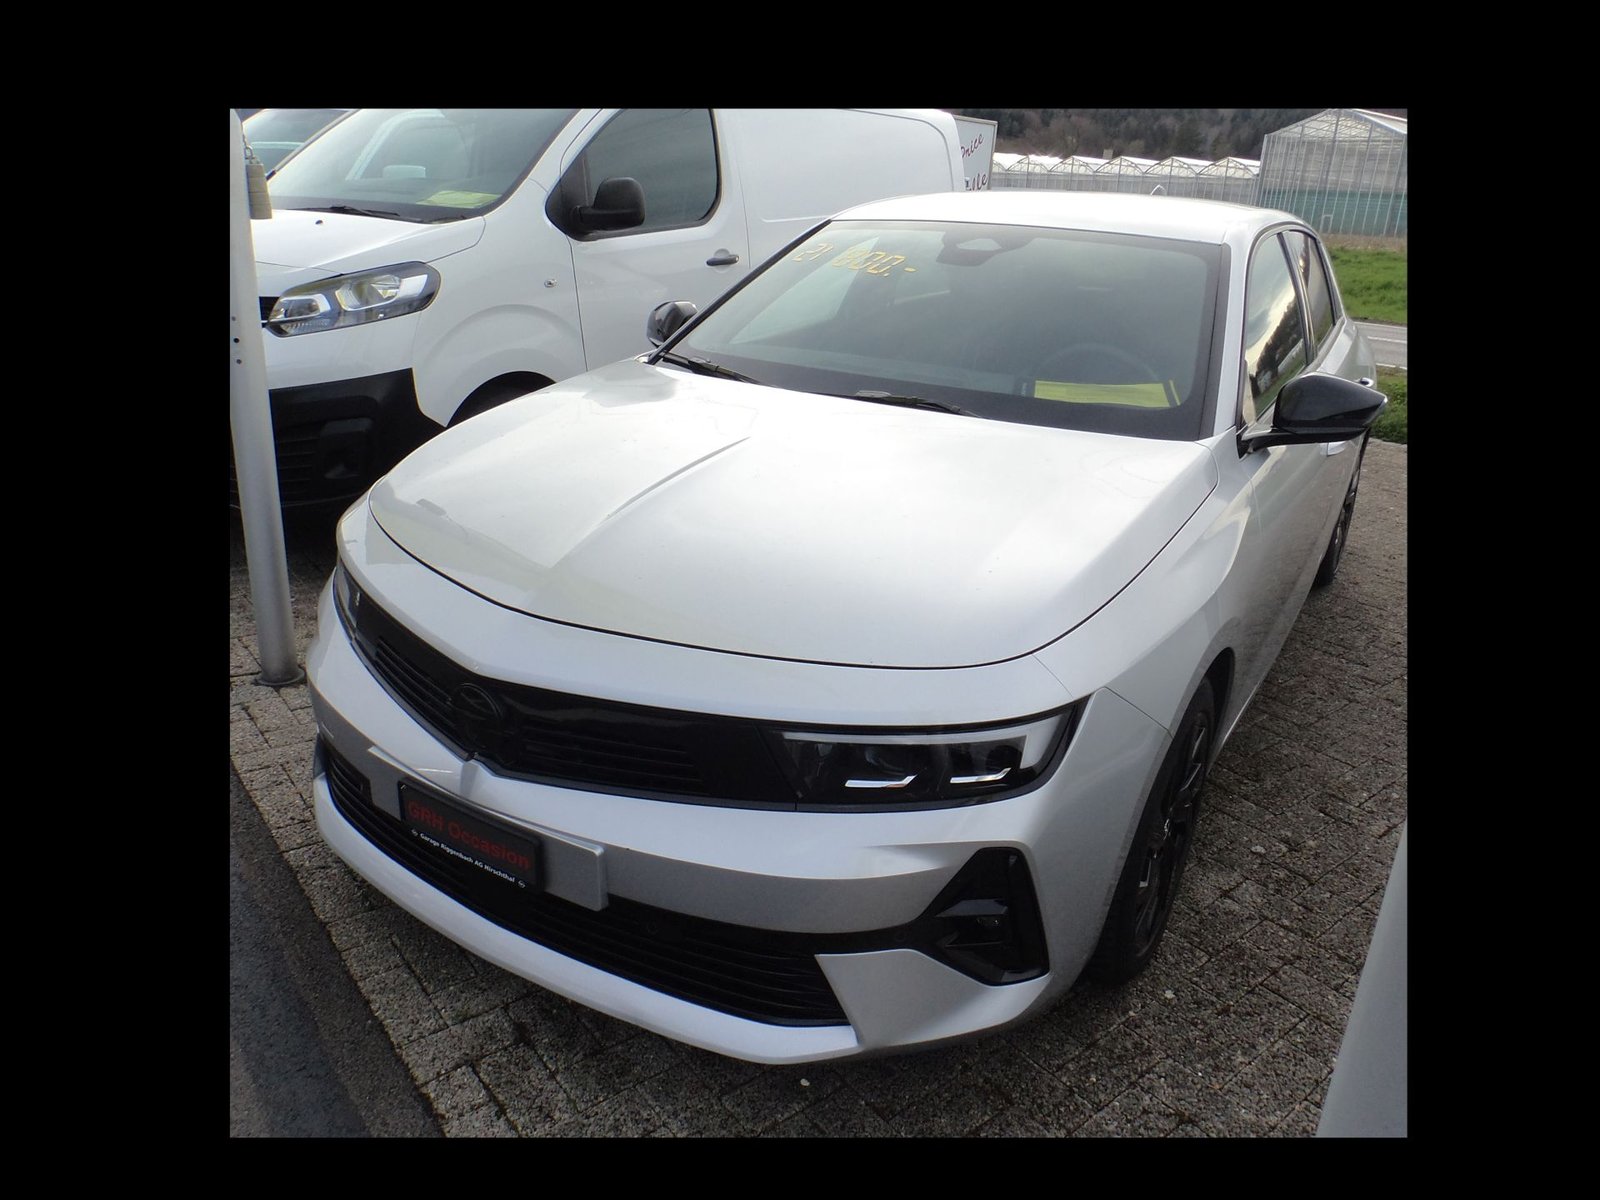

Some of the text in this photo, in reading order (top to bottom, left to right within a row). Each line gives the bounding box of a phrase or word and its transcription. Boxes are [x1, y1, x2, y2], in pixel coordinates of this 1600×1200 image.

[407, 800, 530, 870] GRH Occasion
[420, 833, 440, 847] Garage
[474, 860, 483, 868] AG
[484, 864, 515, 883] Hirschthal
